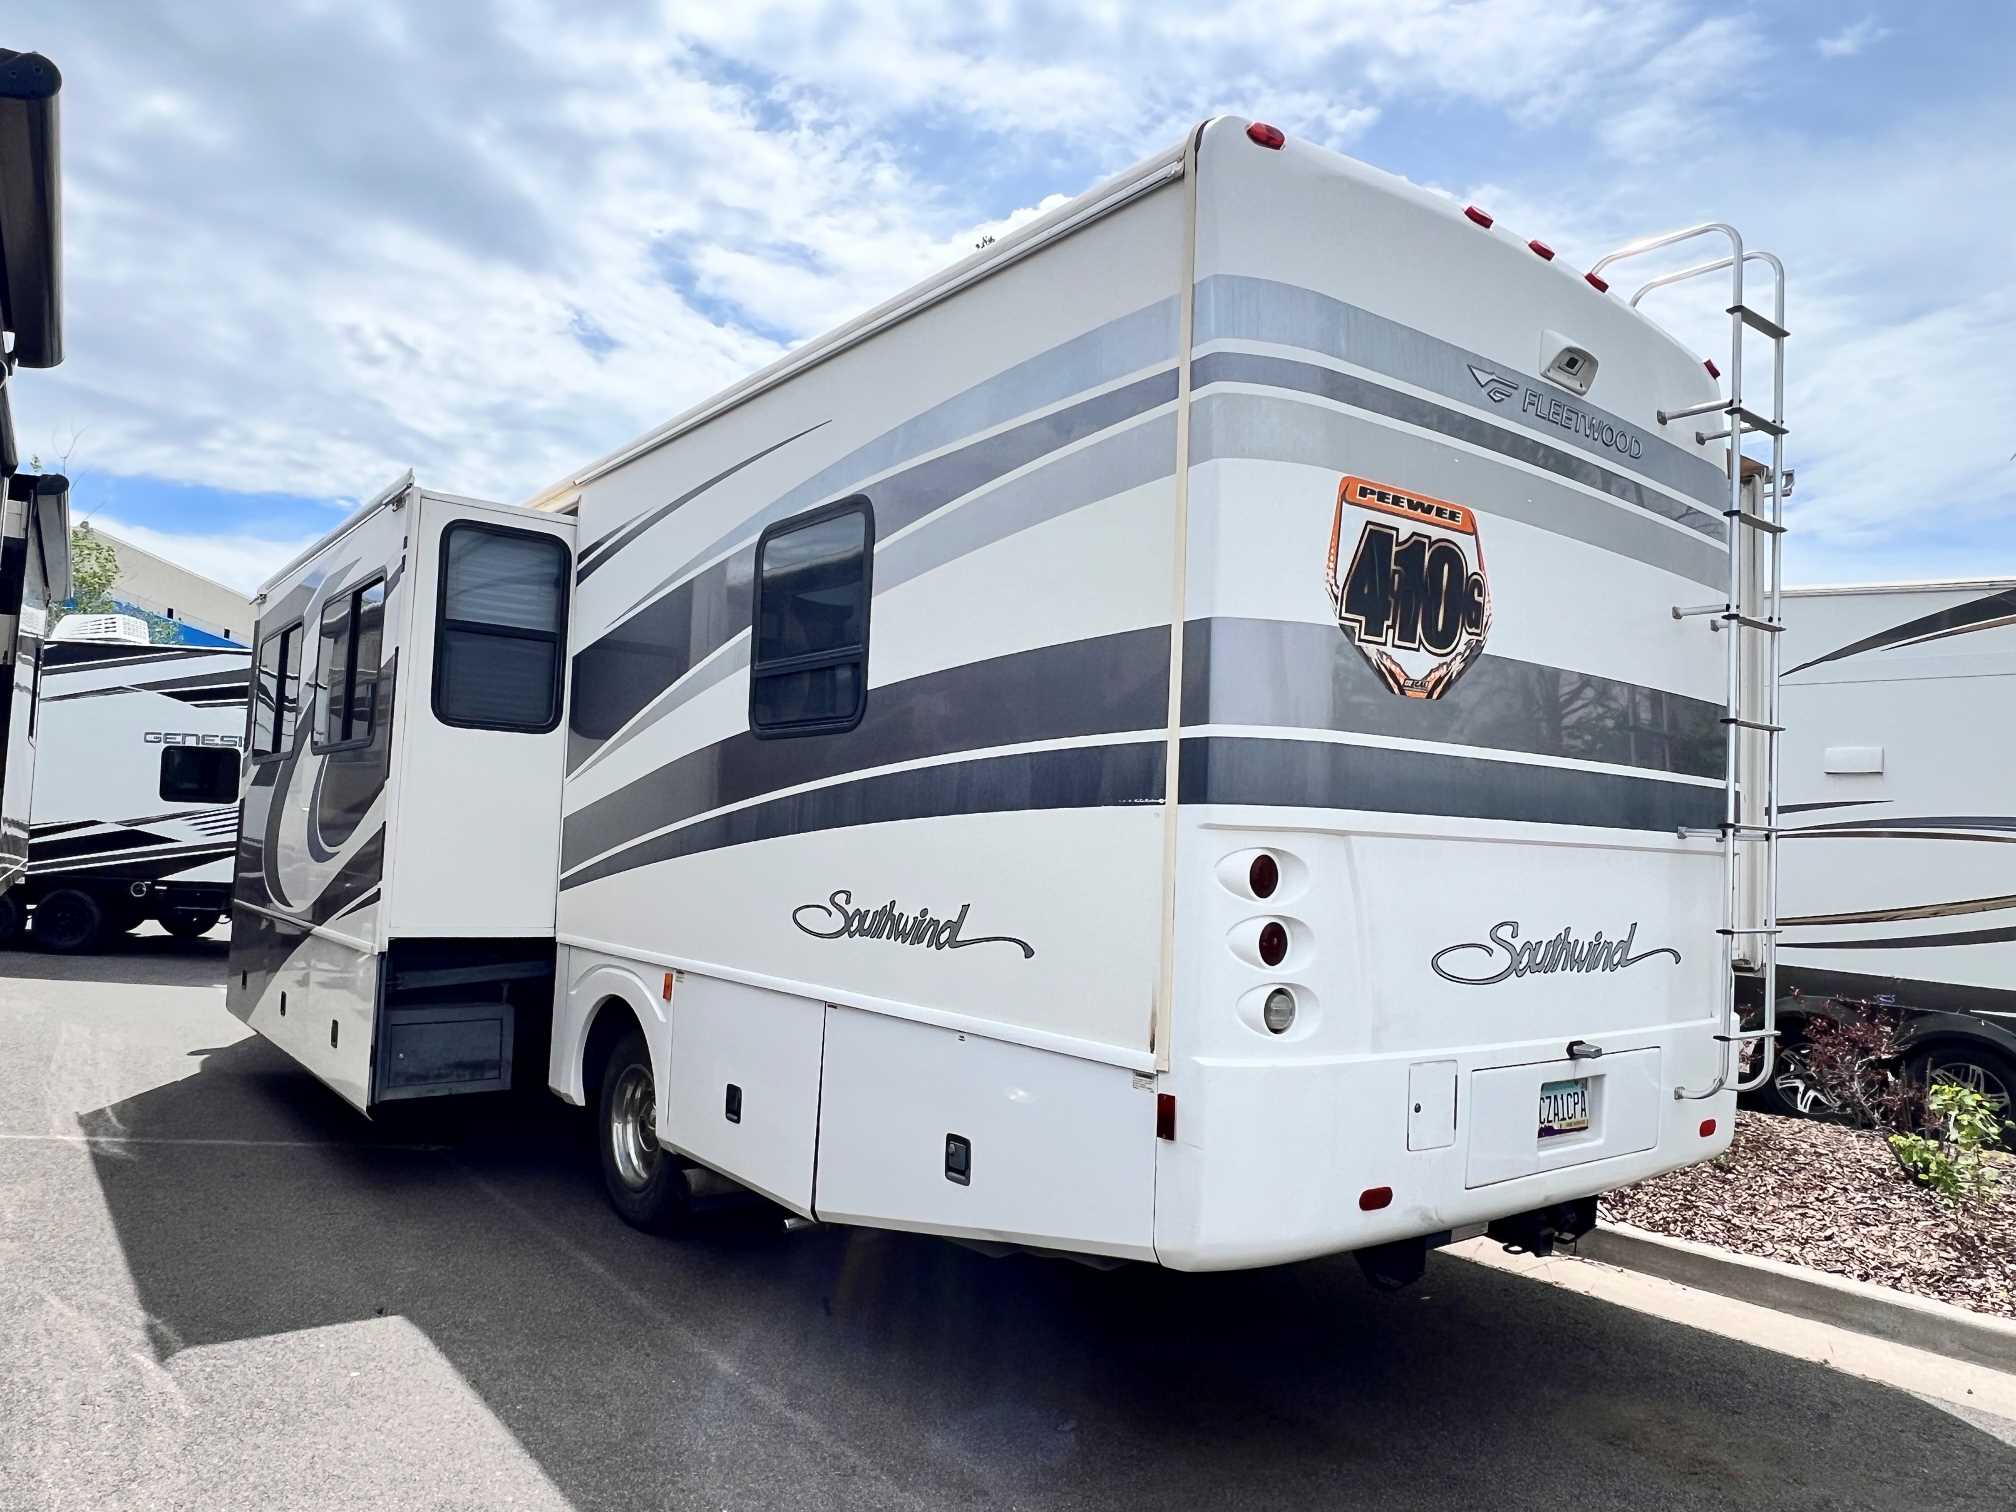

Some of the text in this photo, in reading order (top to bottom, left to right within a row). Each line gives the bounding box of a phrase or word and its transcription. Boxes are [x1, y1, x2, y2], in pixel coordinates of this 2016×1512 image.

[1522, 387, 1642, 459] FLEETWOOD
[1357, 484, 1462, 524] PEEWEE
[144, 732, 243, 747] GENESI
[792, 889, 1035, 959] Southwind
[1431, 921, 1682, 985] Southwind
[1539, 1090, 1587, 1124] CZA1CPA
